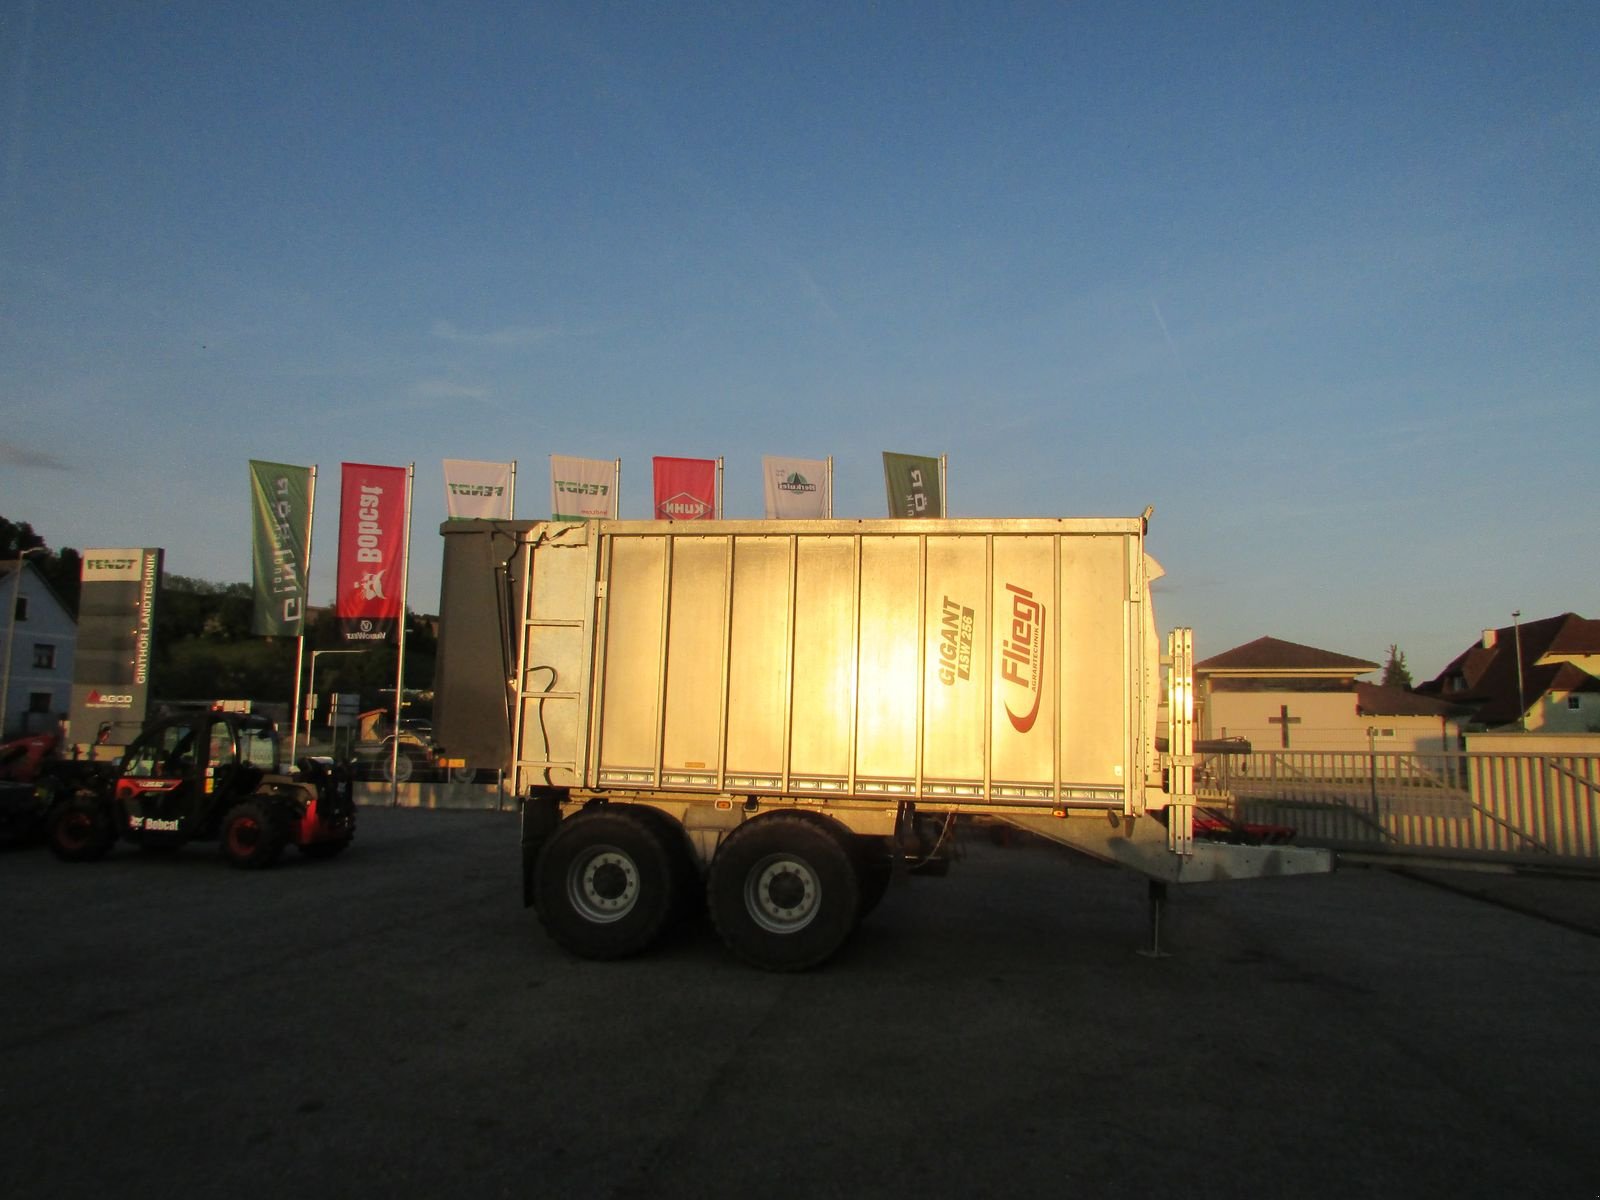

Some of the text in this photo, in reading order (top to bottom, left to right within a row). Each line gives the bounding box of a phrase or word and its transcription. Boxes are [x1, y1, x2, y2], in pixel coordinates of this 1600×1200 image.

[87, 559, 137, 570] FENDT
[142, 553, 156, 631] LANDTECHNIK
[938, 595, 961, 687] GIGANT
[959, 615, 973, 674] ASW 256
[1001, 582, 1040, 689] Fliegl
[1031, 627, 1040, 692] AGRARTECHNIK
[100, 695, 132, 703] AGCO
[144, 817, 178, 831] Bobcat
